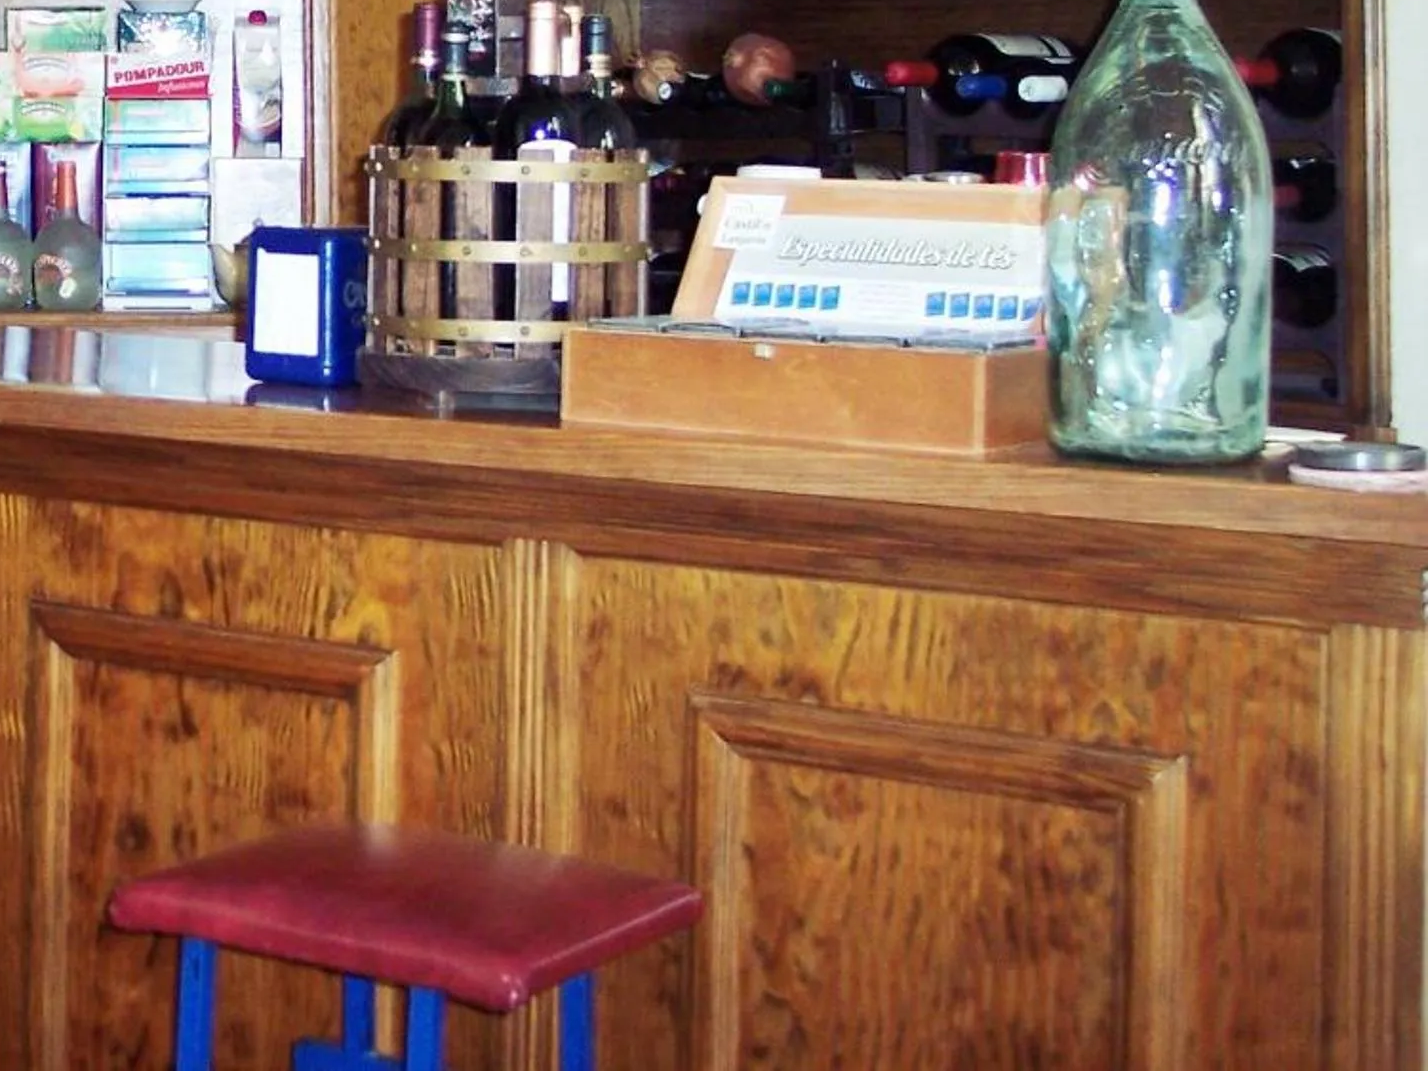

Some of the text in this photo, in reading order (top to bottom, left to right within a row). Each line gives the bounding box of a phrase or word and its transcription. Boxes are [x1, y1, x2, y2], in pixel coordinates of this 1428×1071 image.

[113, 61, 206, 83] POMPADOUR
[778, 234, 1018, 270] Especialidades de tés
